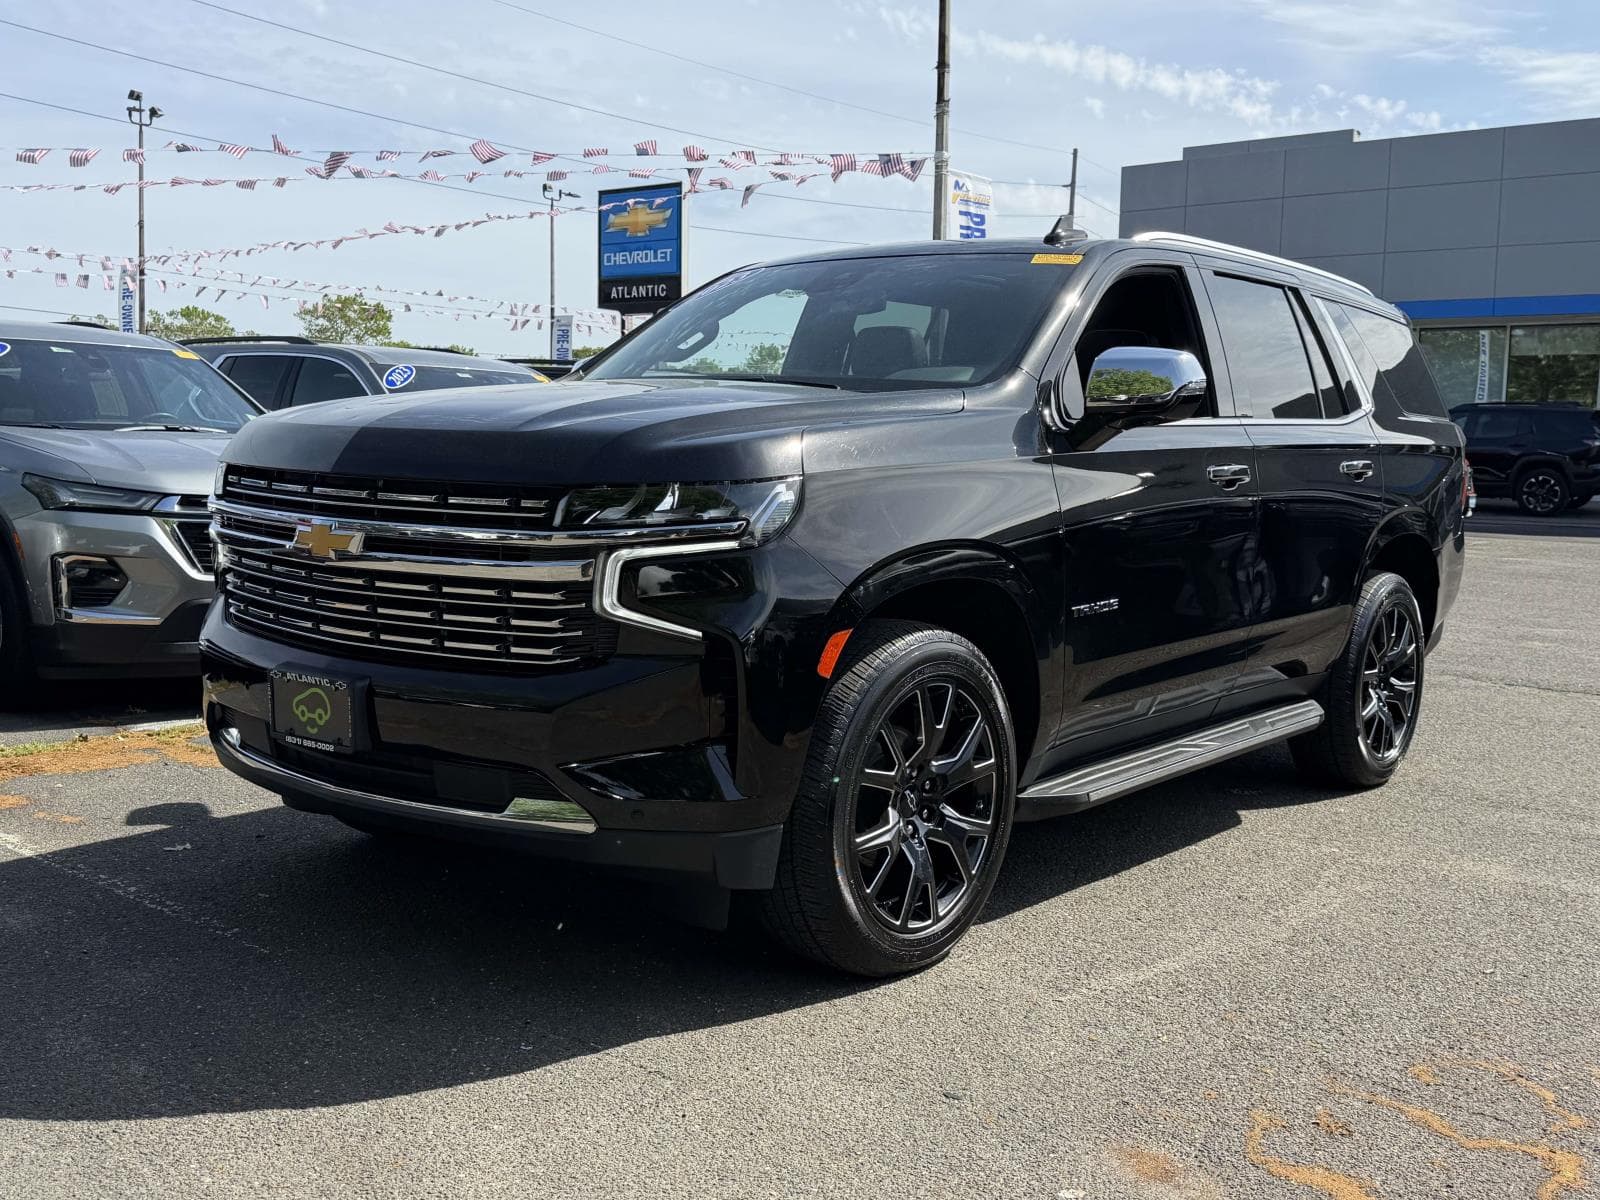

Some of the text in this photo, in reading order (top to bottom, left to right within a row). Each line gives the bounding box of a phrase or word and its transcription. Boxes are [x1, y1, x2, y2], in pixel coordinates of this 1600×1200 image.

[604, 249, 672, 265] CHEVROLET
[611, 285, 667, 299] ATLANTIC
[122, 282, 133, 333] RE-OWNE
[1071, 598, 1119, 617] TAHOE
[286, 673, 331, 687] ATLANTIC
